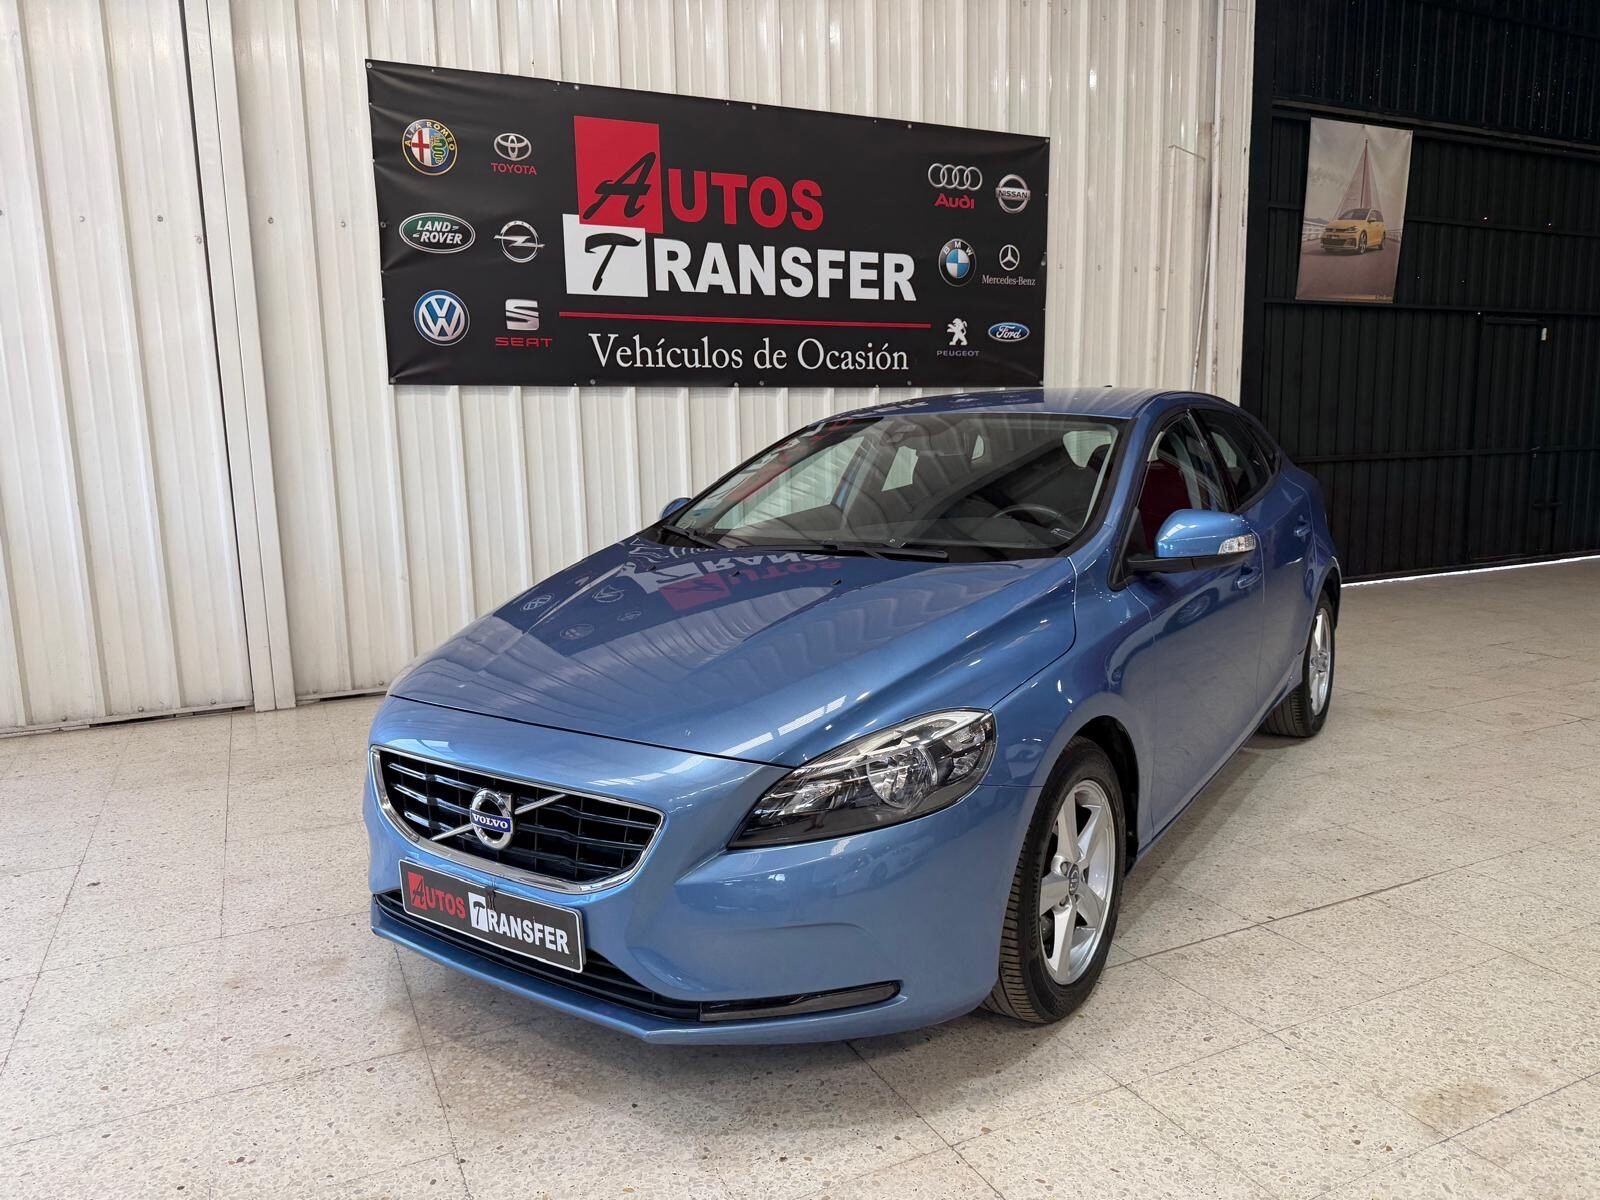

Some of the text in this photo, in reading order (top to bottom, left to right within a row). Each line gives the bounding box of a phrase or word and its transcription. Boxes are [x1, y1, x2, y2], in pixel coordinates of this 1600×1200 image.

[404, 121, 456, 151] ALFA ROMEO
[491, 162, 537, 175] TOYOTA
[582, 152, 824, 231] AUTOS
[998, 190, 1028, 199] NISSAN
[935, 193, 976, 209] Audi
[416, 220, 452, 232] LAND
[420, 232, 463, 244] ROVER
[943, 241, 974, 257] BMW
[584, 233, 917, 301] TRANSFER
[982, 275, 1036, 286] Mercedes-Benz
[996, 325, 1022, 339] Ford
[495, 336, 553, 348] SEAT
[587, 332, 910, 371] Vehículos de Ocasión
[471, 813, 509, 830] VOLVO
[411, 878, 570, 955] AUTOS TRANSFER
